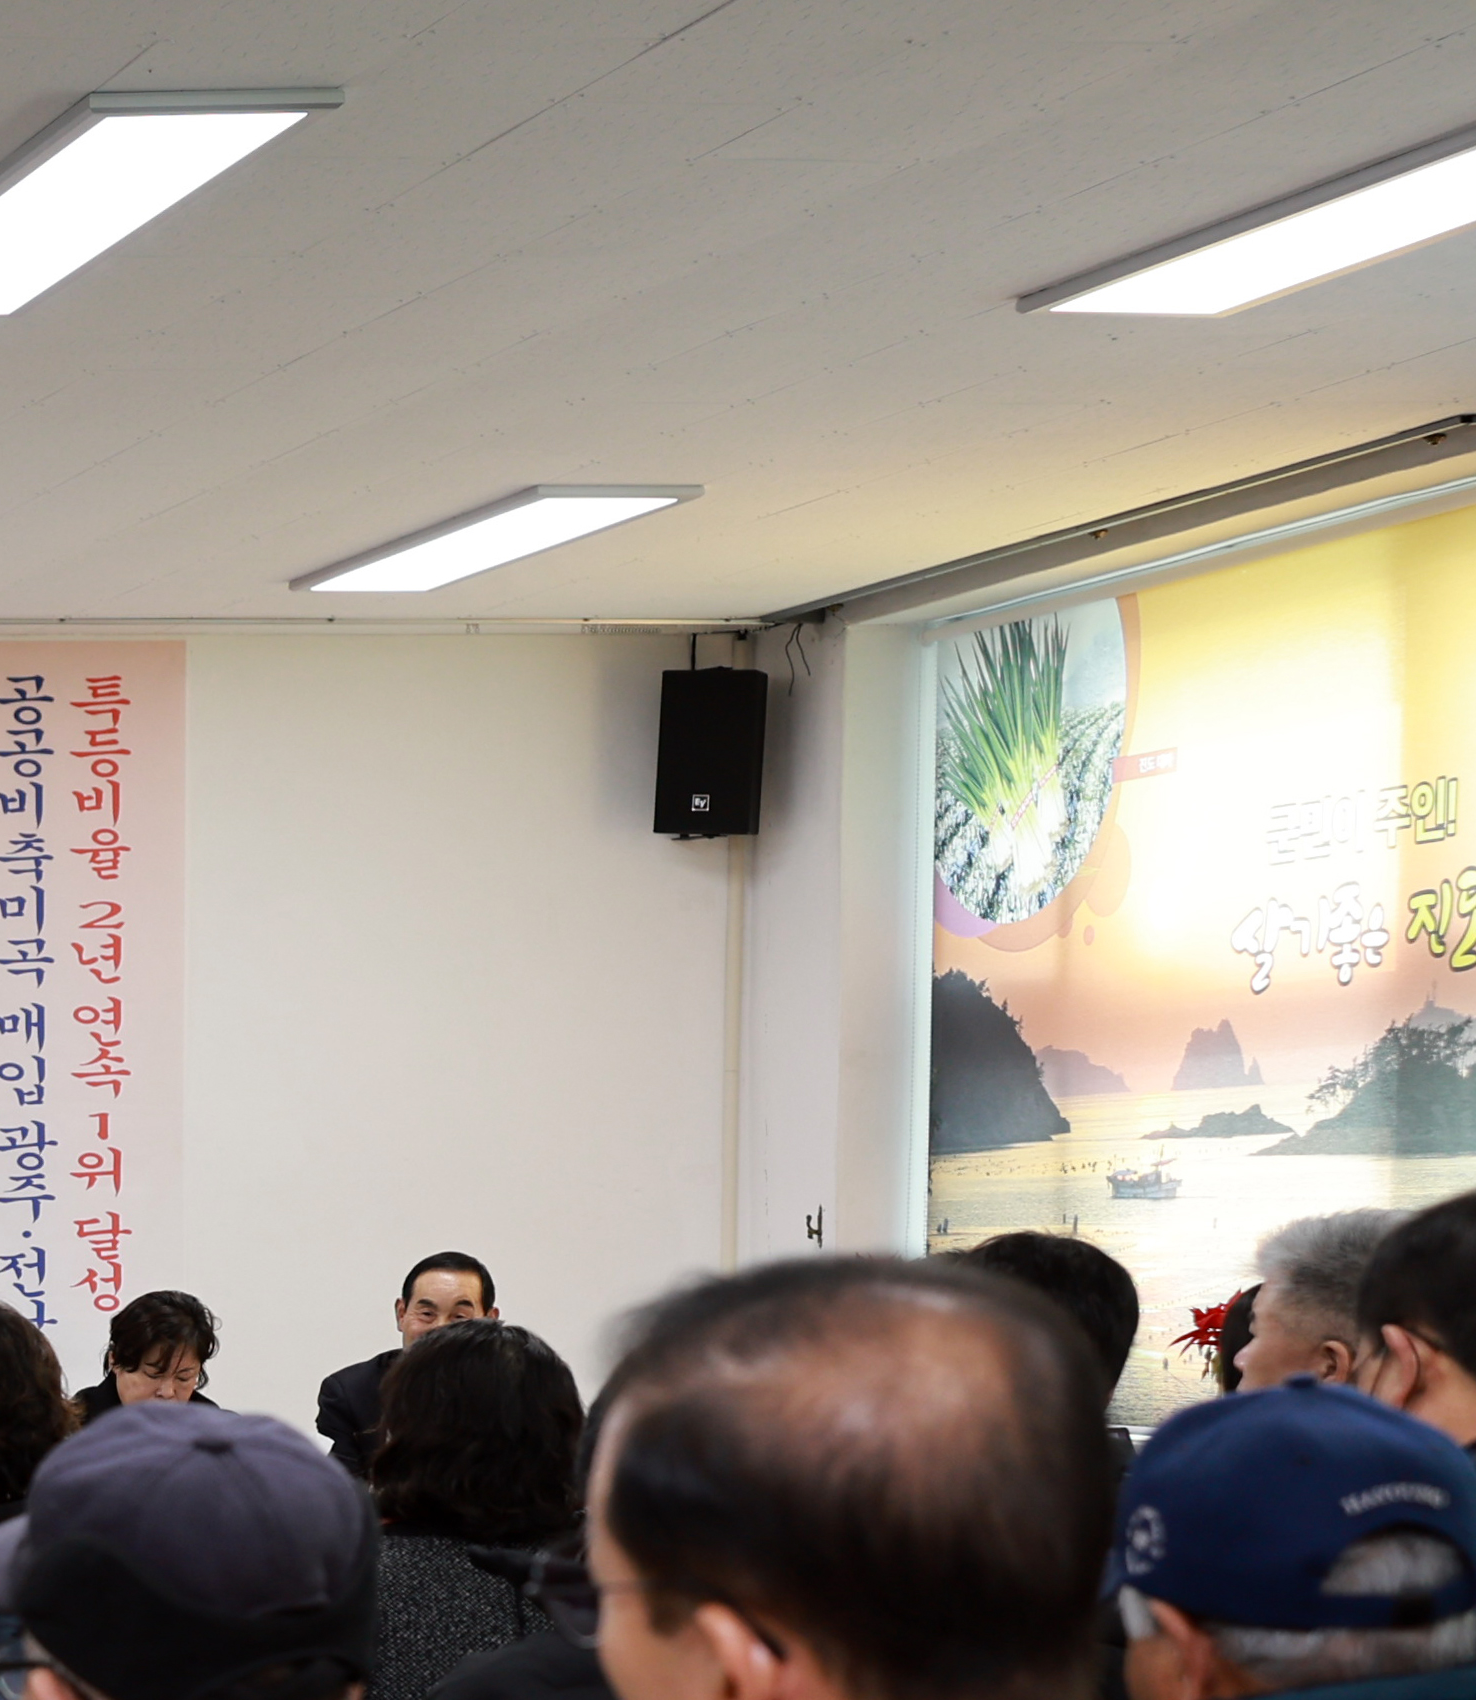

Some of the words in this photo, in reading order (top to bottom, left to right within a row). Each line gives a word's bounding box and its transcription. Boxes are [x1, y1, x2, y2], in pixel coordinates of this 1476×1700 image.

[70, 675, 131, 880] 특등비율
[1373, 776, 1459, 849] 주인!
[71, 901, 125, 984] 2년
[1230, 880, 1390, 995] 살기좋은
[71, 996, 131, 1098] 연속
[70, 1211, 132, 1312] 달성
